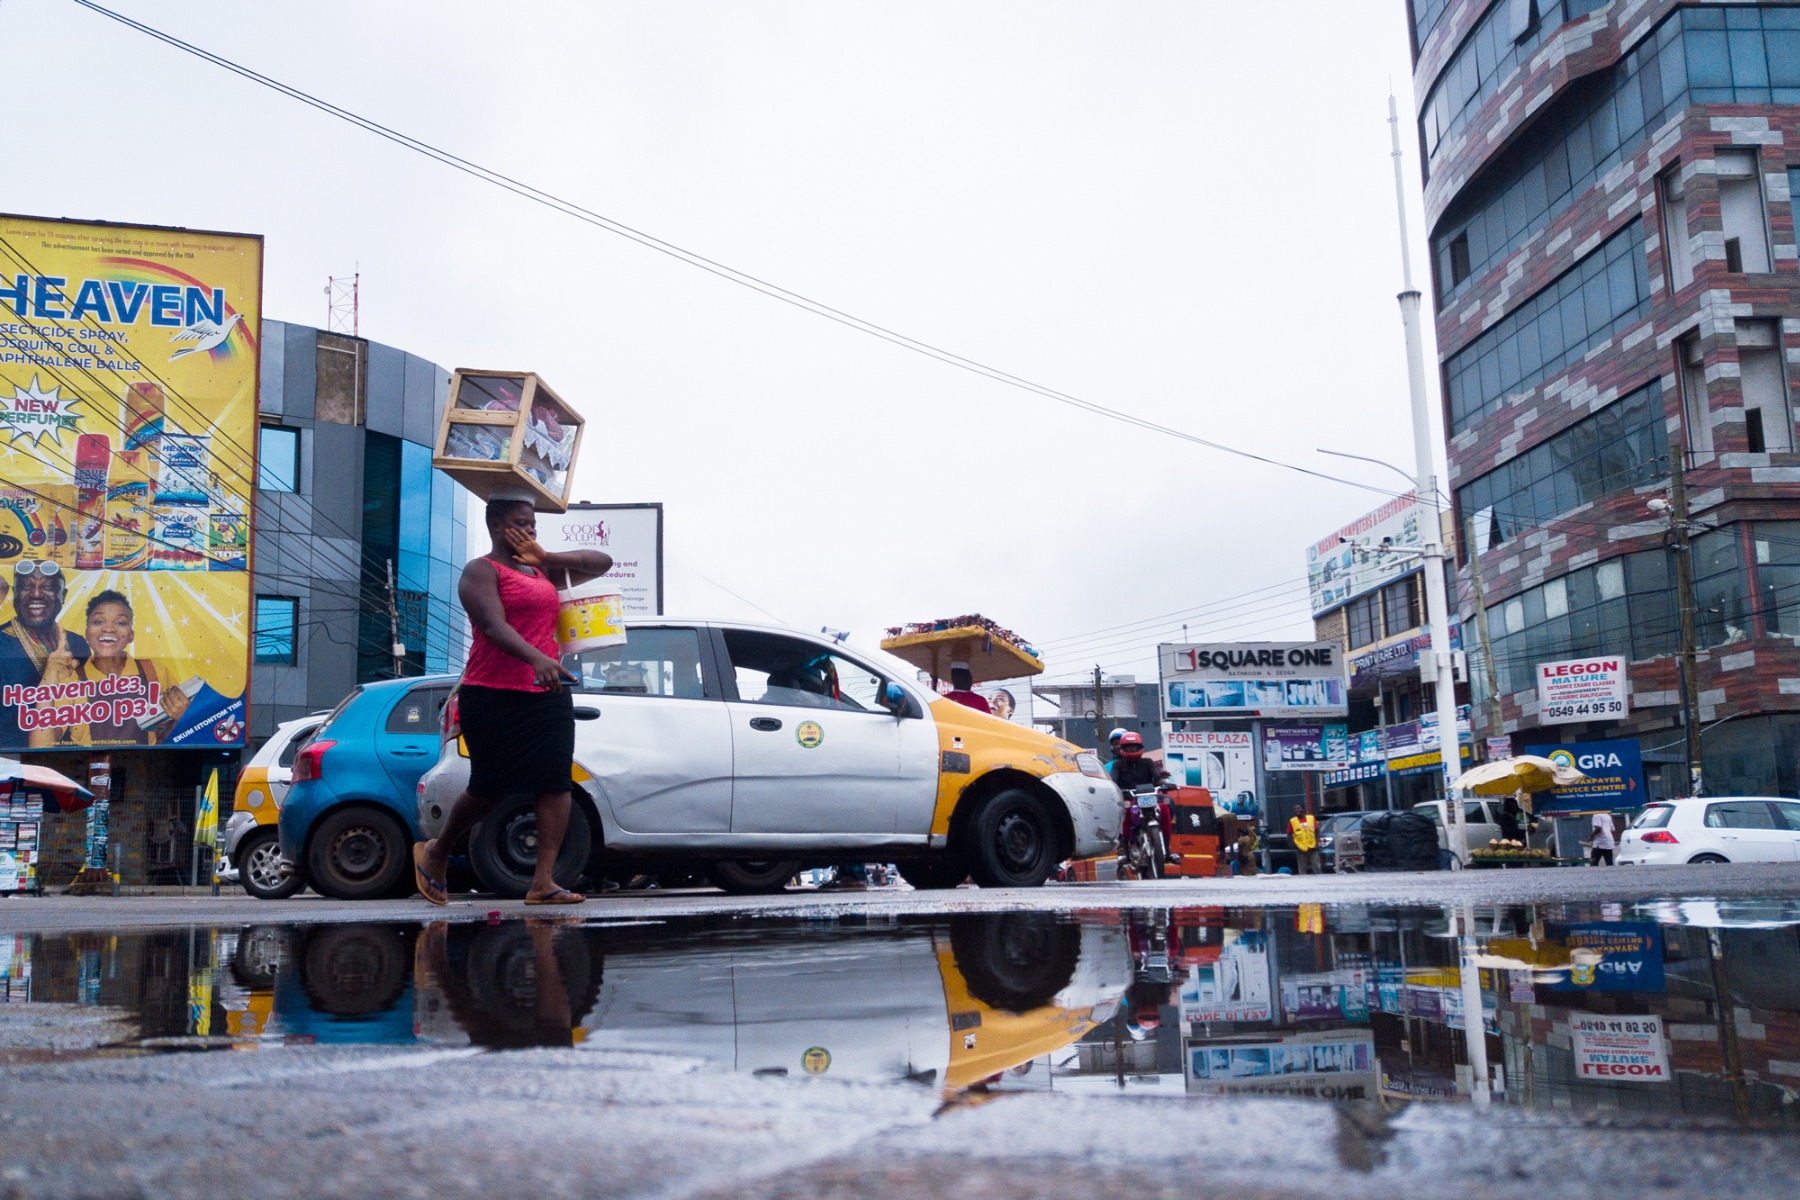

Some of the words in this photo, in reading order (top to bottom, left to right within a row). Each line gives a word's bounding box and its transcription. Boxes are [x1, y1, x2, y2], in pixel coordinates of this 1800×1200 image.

[53, 242, 90, 252] advertisement
[0, 274, 224, 327] HEAVEN
[80, 329, 128, 343] SPRAY,
[68, 343, 100, 355] COIL
[104, 345, 114, 356] &
[96, 359, 140, 370] BALLS
[15, 399, 59, 413] NEW
[1198, 649, 1284, 670] SQUARE
[1288, 648, 1332, 666] ONE
[1544, 661, 1618, 678] LEGON
[1552, 674, 1608, 684] MATURE
[4, 681, 95, 706] Heaven
[18, 701, 111, 730] baako
[1549, 706, 1574, 718] 0549
[1576, 704, 1590, 714] 44
[1592, 702, 1606, 714] 95
[1608, 701, 1622, 712] 50
[172, 728, 194, 743] EKUM
[1168, 733, 1204, 744] FONE
[1208, 733, 1250, 744] PLAZA
[1578, 752, 1622, 770] GRA
[1551, 786, 1590, 794] SERVICE
[1591, 784, 1626, 792] CENTRE
